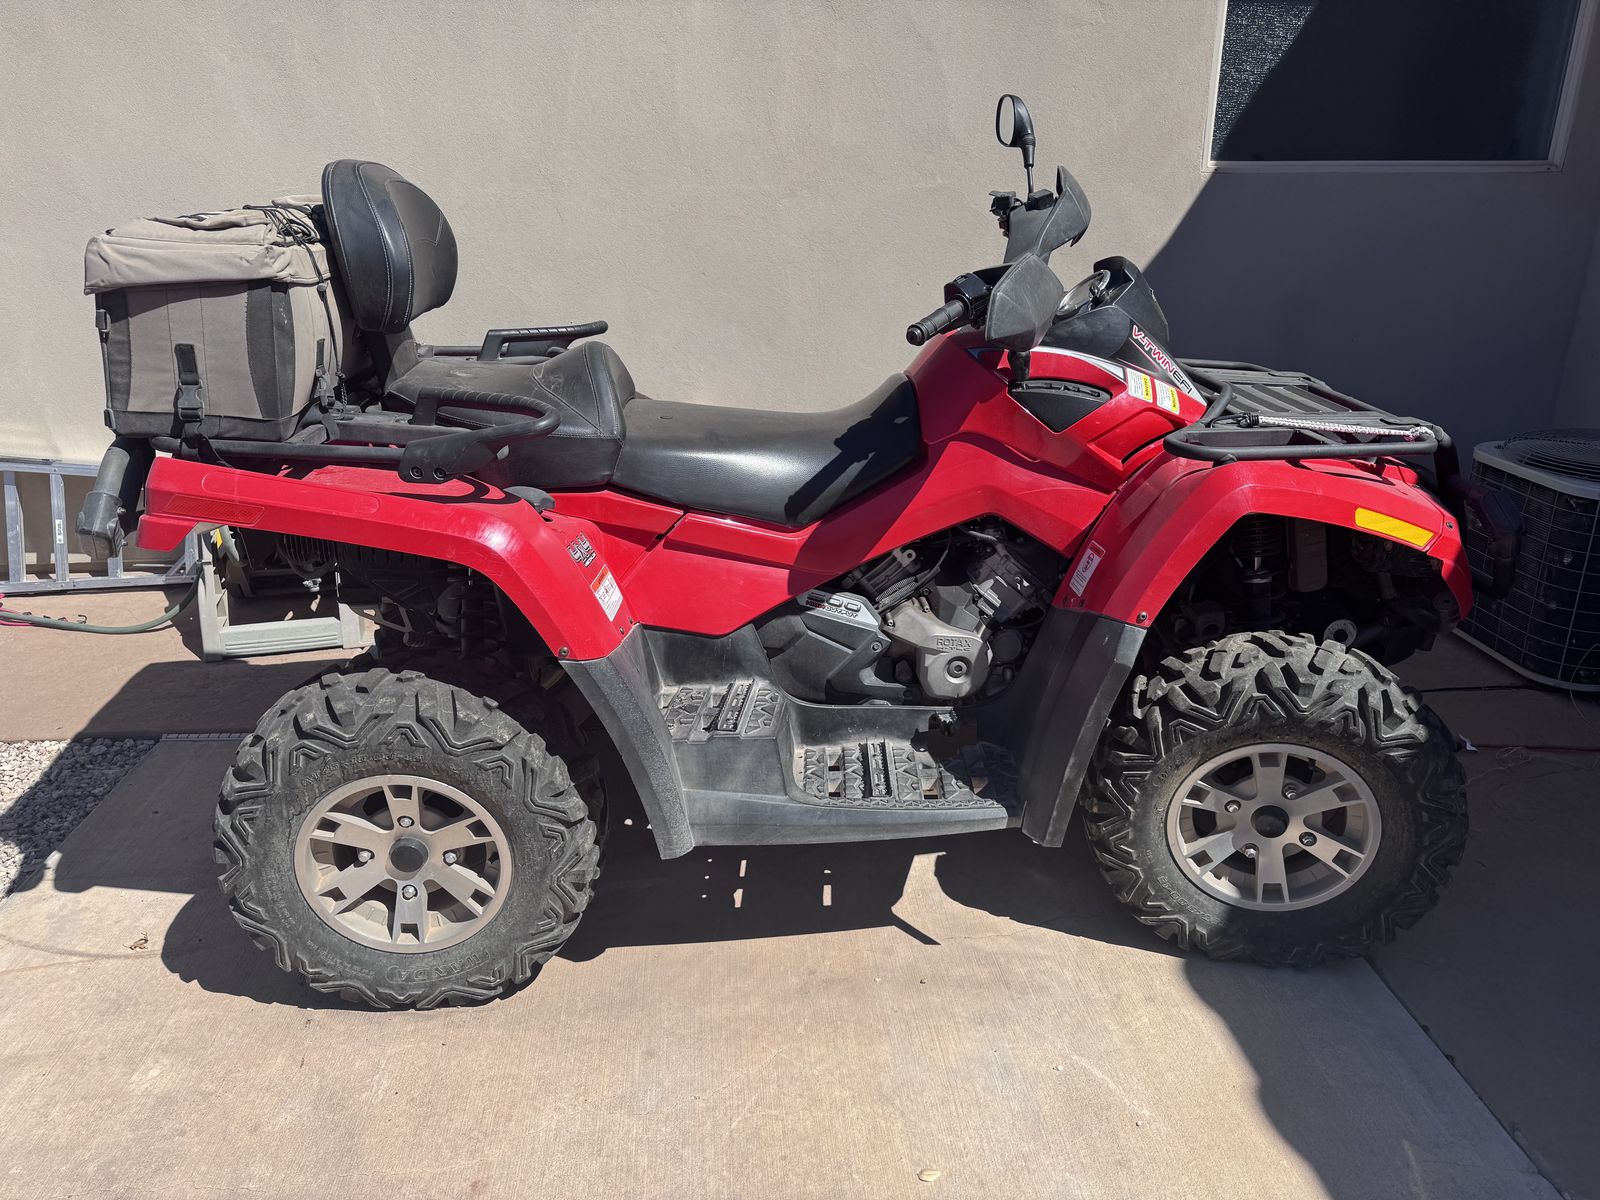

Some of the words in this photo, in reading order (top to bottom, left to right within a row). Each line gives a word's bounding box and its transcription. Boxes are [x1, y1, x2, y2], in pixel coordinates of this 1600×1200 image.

[1131, 325, 1175, 374] V-TWIN
[1173, 369, 1193, 394] EFI
[936, 638, 971, 648] ROTAX
